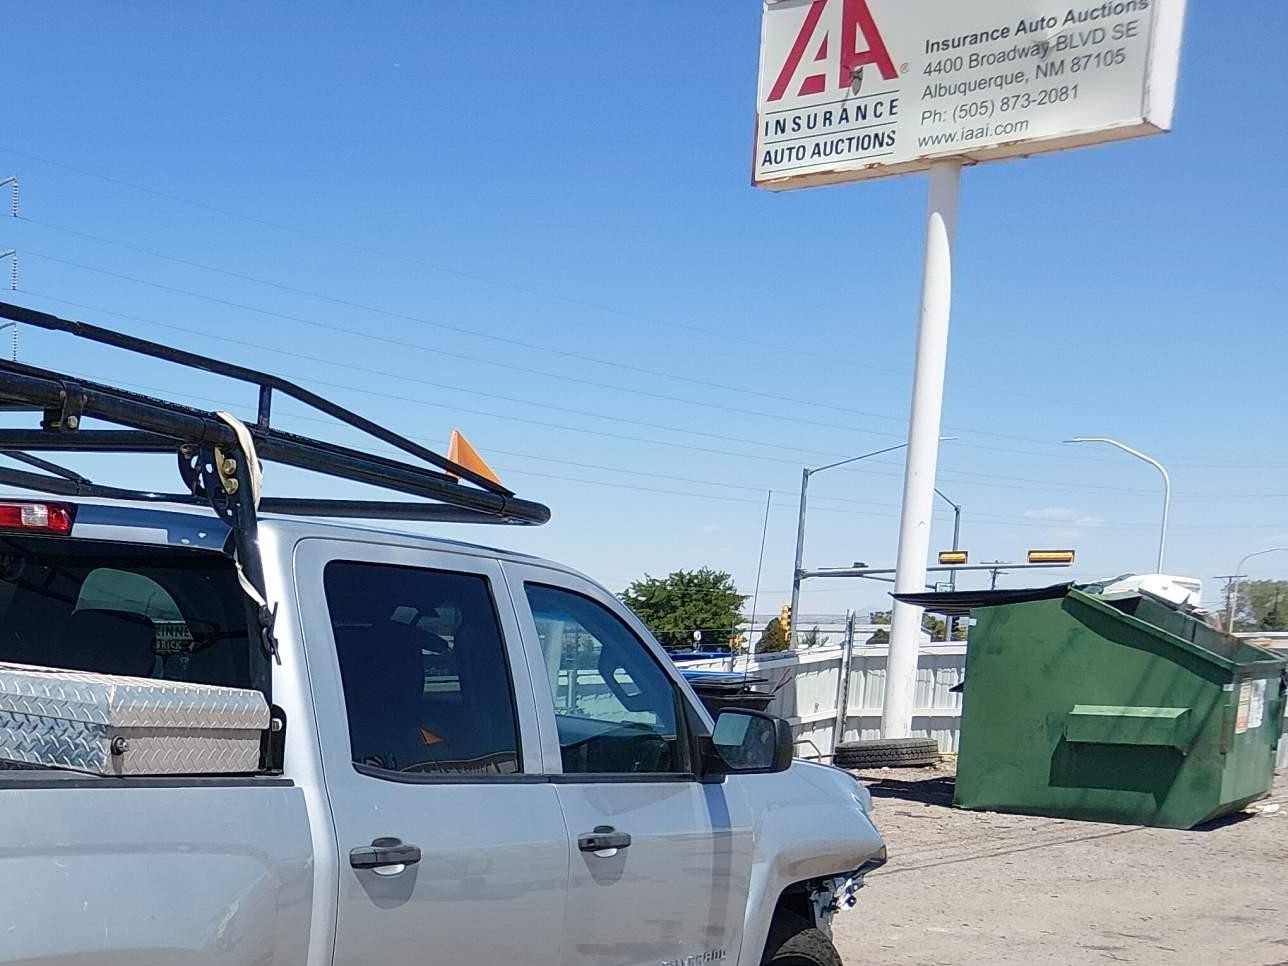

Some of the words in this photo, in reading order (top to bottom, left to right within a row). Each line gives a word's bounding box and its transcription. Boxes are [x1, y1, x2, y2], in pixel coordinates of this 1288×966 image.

[923, 55, 963, 76] 4400
[968, 40, 1050, 69] Broadway
[1055, 26, 1106, 52] BLVD
[1111, 20, 1139, 41] SE
[925, 26, 1010, 54] Insurance
[1014, 16, 1058, 36] Auto
[1062, 0, 1149, 26] Auctions
[921, 70, 1029, 100] Albuquerque,
[1035, 59, 1065, 80] NM
[1070, 47, 1126, 74] 87105
[764, 98, 899, 137] INSURANCE
[921, 109, 947, 126] Ph:
[952, 99, 995, 123] (505)
[999, 82, 1079, 112] 873-2081
[762, 144, 807, 167] AUTO
[810, 129, 896, 159] AUCTIONS
[918, 119, 1029, 148] www.iaai.com
